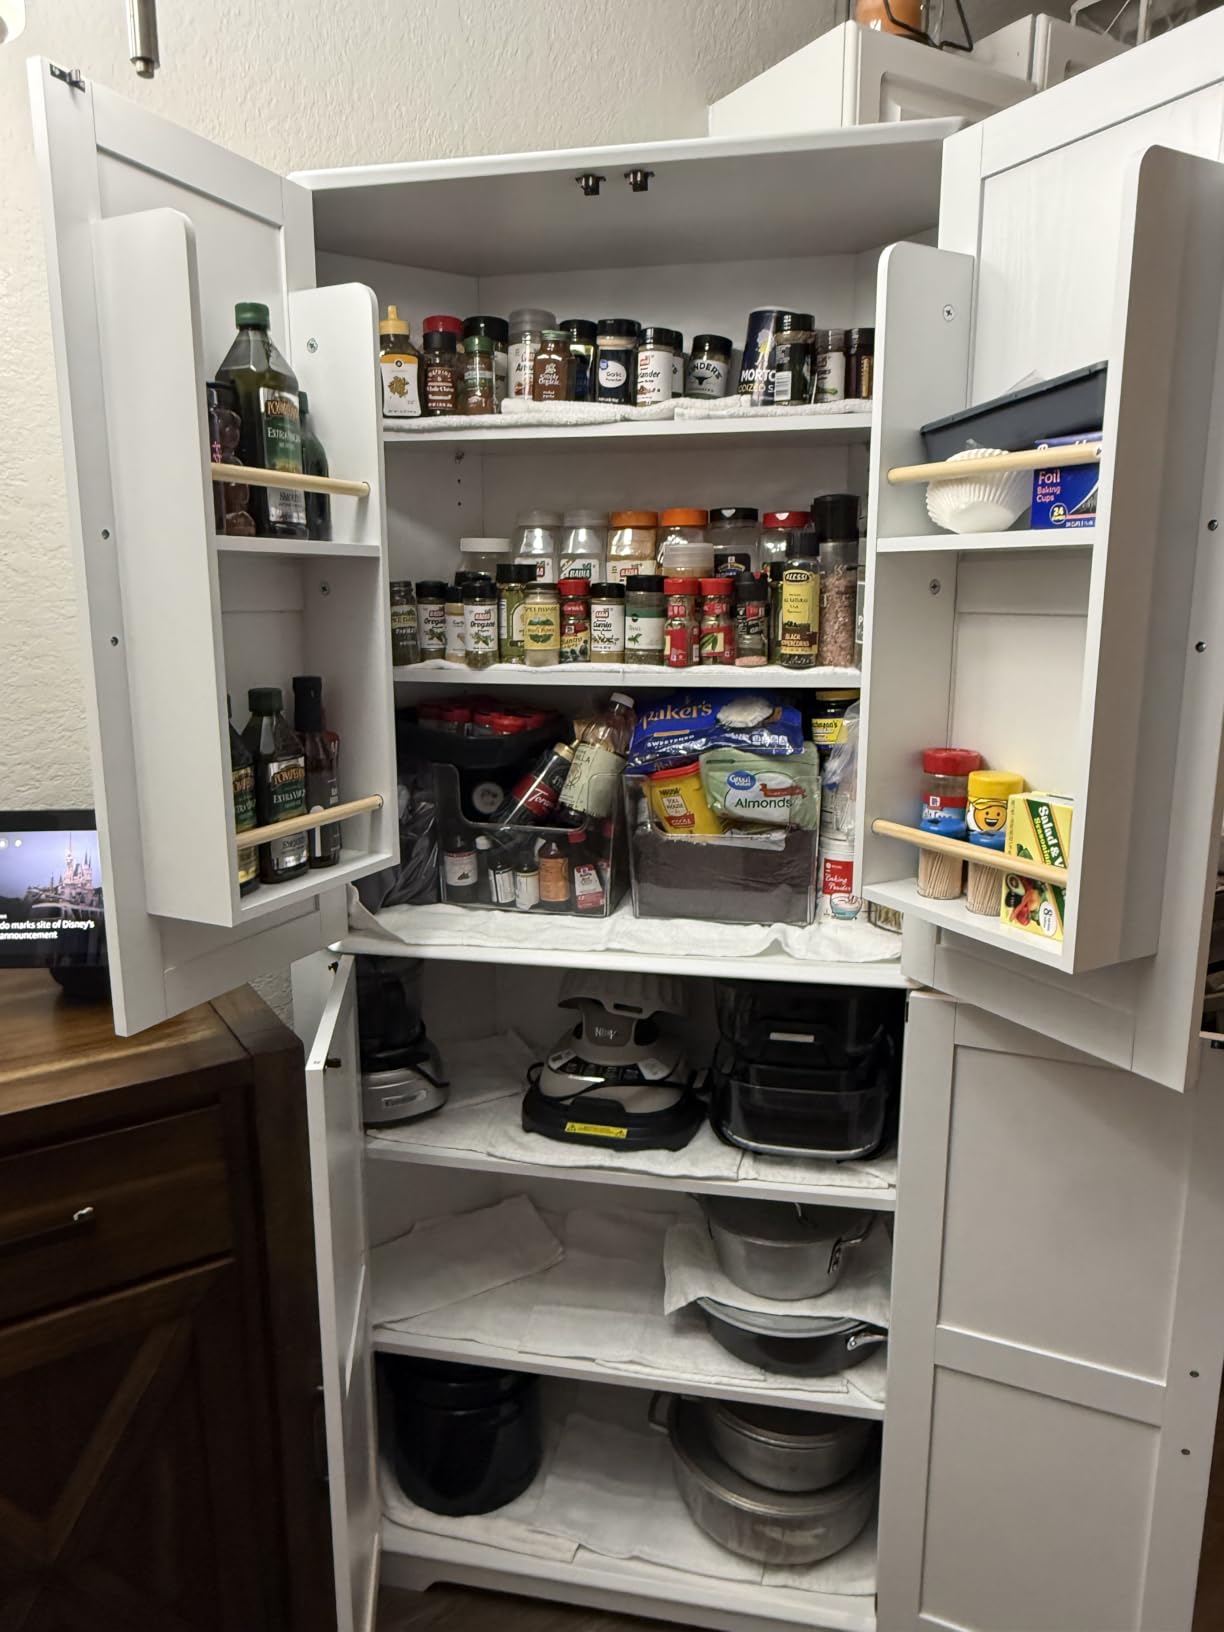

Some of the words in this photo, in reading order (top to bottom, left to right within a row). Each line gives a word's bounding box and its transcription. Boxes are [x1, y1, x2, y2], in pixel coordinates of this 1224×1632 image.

[1038, 469, 1061, 485] Foil
[1037, 486, 1061, 495] Baking
[1036, 494, 1055, 503] Cups
[734, 797, 793, 808] Almonds
[1038, 805, 1059, 846] Salad
[1050, 845, 1060, 858] &
[11, 921, 36, 929] marks
[36, 920, 51, 929] site
[52, 919, 62, 929] of
[62, 920, 95, 930] Disney's
